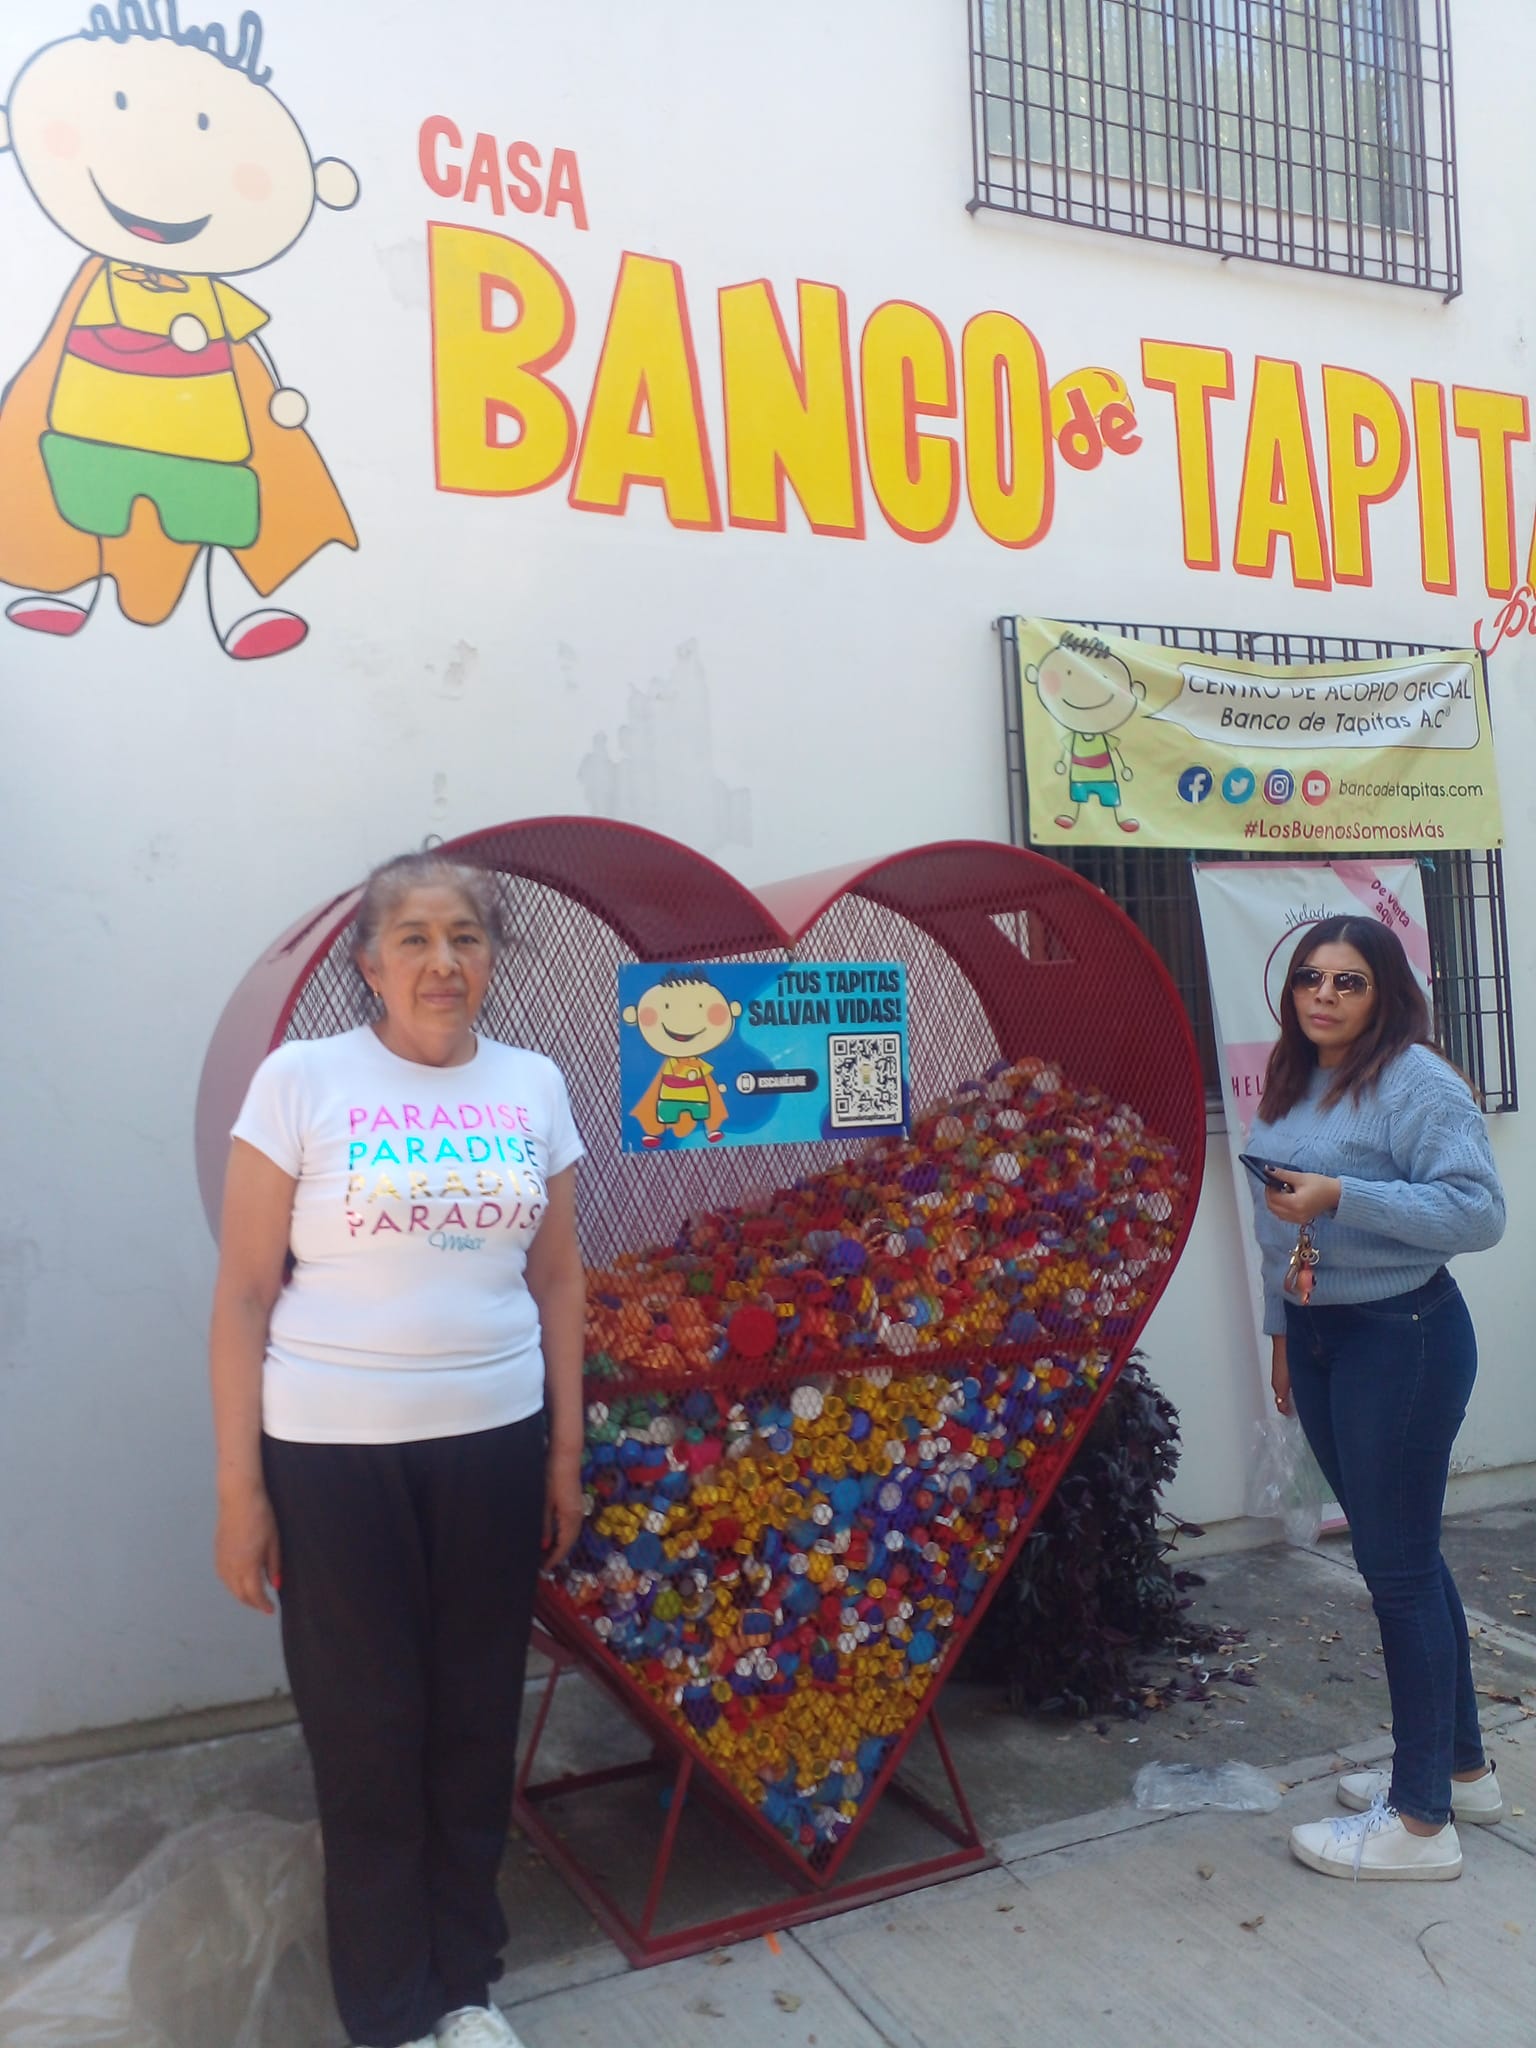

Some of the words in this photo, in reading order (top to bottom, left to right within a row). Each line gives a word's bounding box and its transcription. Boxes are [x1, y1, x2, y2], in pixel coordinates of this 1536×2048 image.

[418, 114, 590, 231] CASA
[427, 219, 1055, 550] BANCO
[1058, 387, 1143, 471] de
[1140, 337, 1536, 601] TAPIT
[1189, 675, 1281, 699] CENTRO
[1290, 687, 1316, 701] DE
[1325, 681, 1399, 702] ACOPIO
[1403, 678, 1472, 702] OFICIAL
[1220, 707, 1291, 731] Banco
[1298, 711, 1326, 732] de
[1336, 712, 1411, 737] Tapitas
[1338, 779, 1484, 801] bancodetapitas.com
[1243, 818, 1446, 840] #LosBuenosSomosMás
[1285, 901, 1336, 927] Helade
[1371, 879, 1387, 897] De
[1388, 894, 1410, 928] venta
[777, 970, 821, 998] ¡TUS
[826, 969, 900, 993] TAPITAS
[749, 999, 830, 1027] SALVAN
[835, 997, 903, 1024] VIDAS!
[1231, 1075, 1263, 1097] HEL
[348, 1103, 533, 1135] PARADISE
[348, 1136, 539, 1170] PARADISE
[345, 1169, 541, 1205] PARADIS
[345, 1202, 541, 1238] PARADIS
